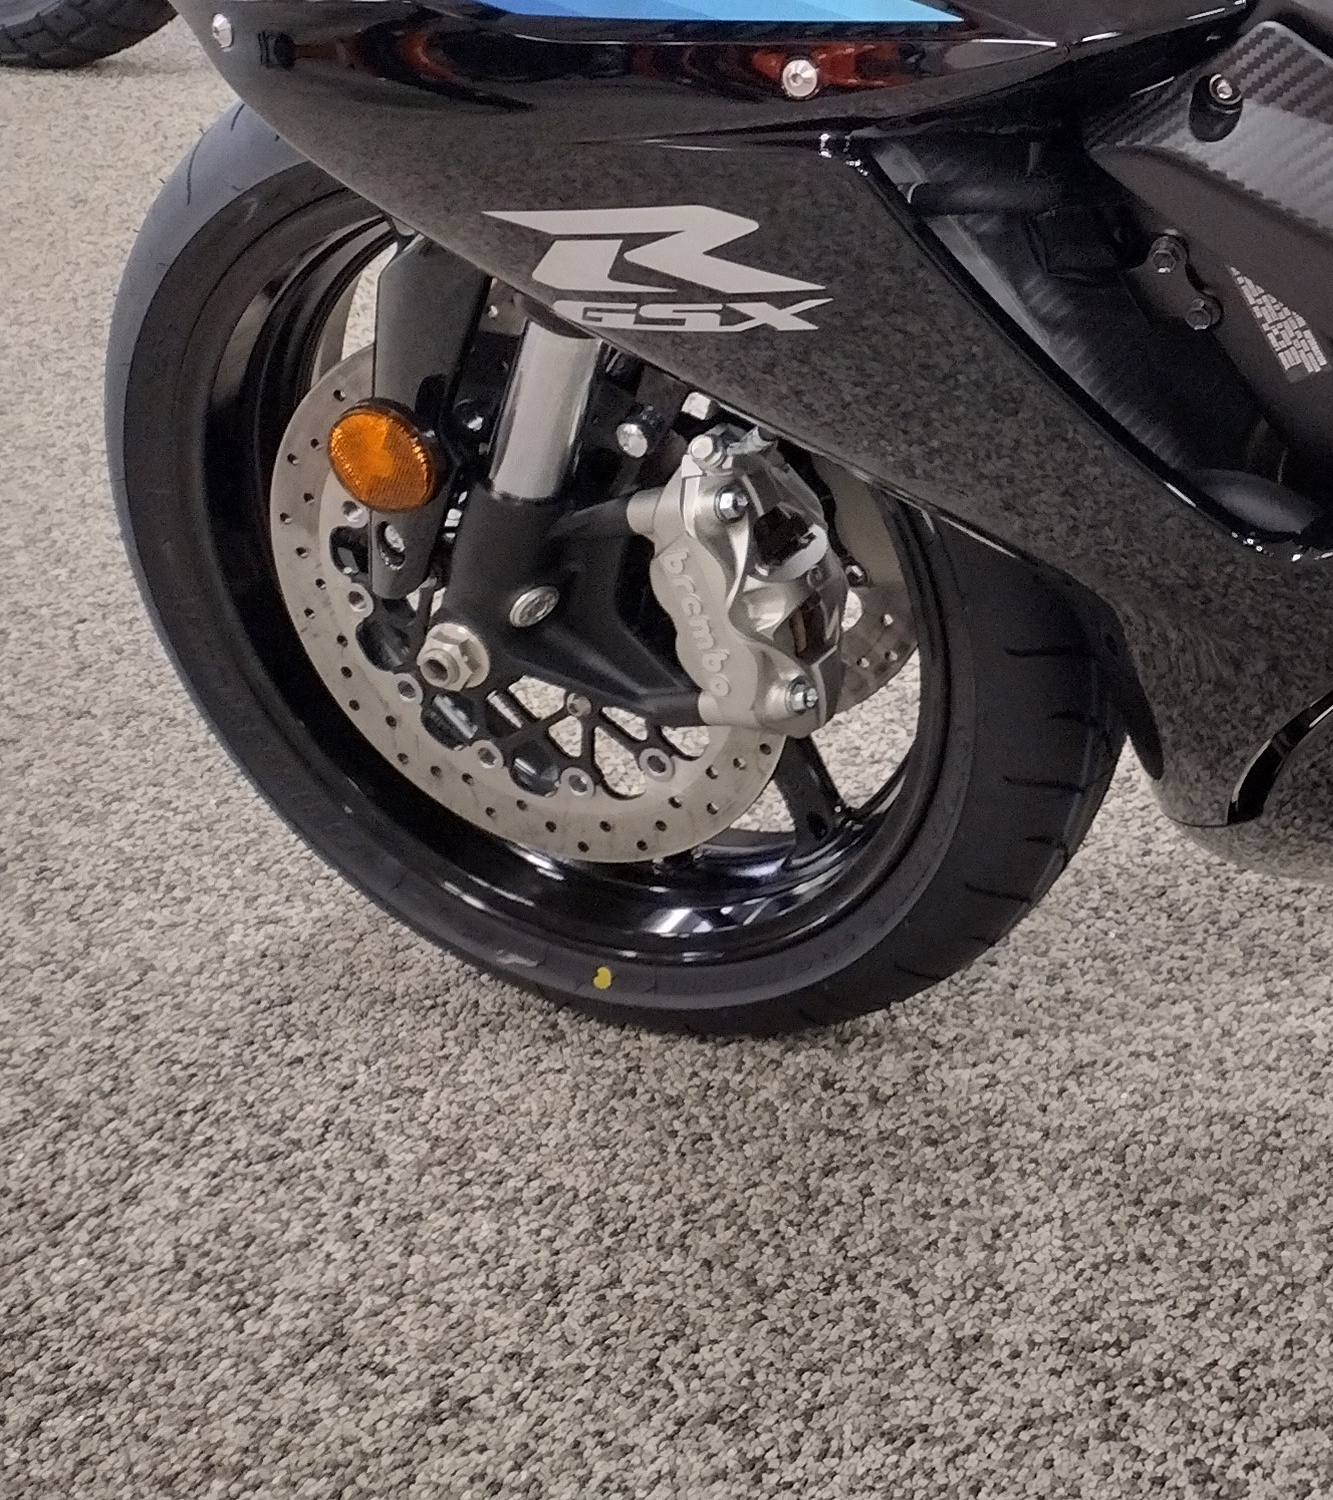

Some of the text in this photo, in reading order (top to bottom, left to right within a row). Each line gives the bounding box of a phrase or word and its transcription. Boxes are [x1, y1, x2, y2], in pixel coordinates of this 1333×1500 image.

[481, 204, 826, 294] R
[552, 298, 833, 333] GSX
[663, 550, 731, 697] brembo
